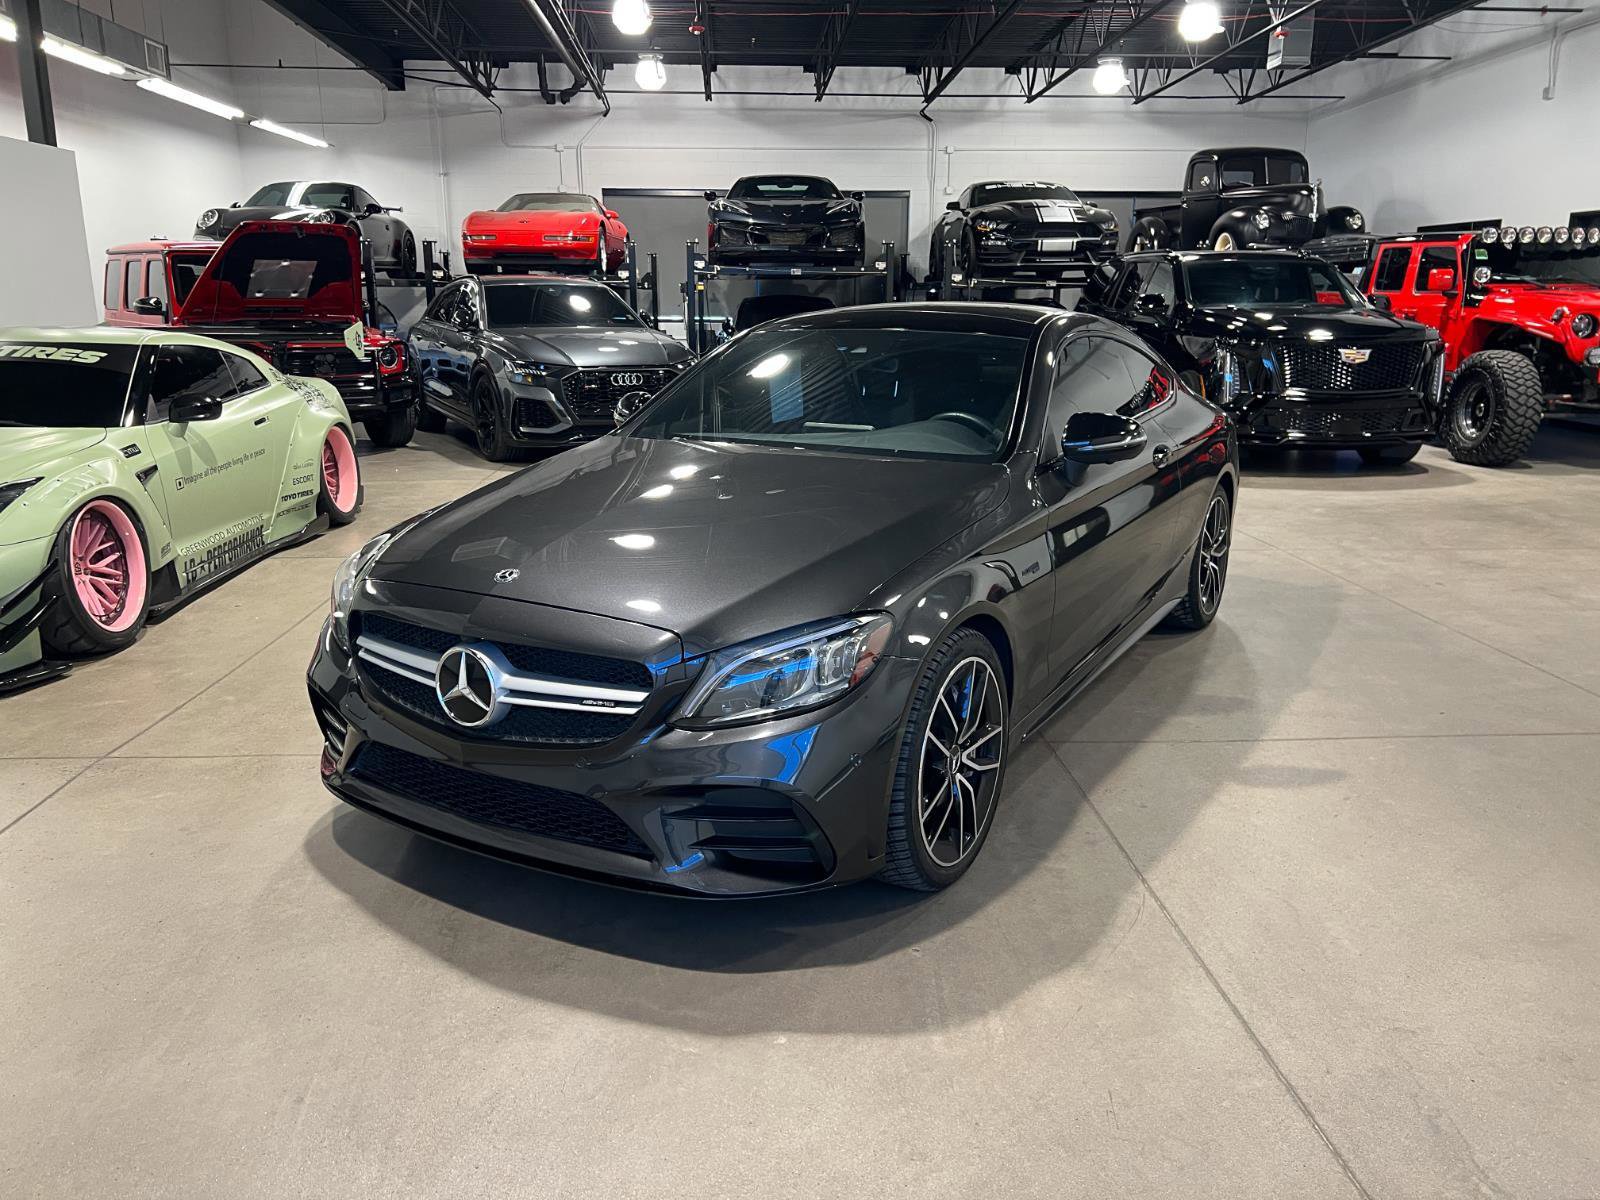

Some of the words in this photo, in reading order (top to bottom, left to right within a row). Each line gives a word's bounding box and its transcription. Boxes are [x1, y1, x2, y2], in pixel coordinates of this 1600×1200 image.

[0, 345, 109, 364] TIRES
[184, 471, 204, 485] Imagine
[217, 460, 232, 473] people
[292, 473, 314, 486] ESCORT
[281, 492, 297, 502] TOYO
[297, 488, 314, 499] TIRES
[180, 532, 226, 557] GREENWOOD
[226, 513, 264, 535] AUTOMOTIVE
